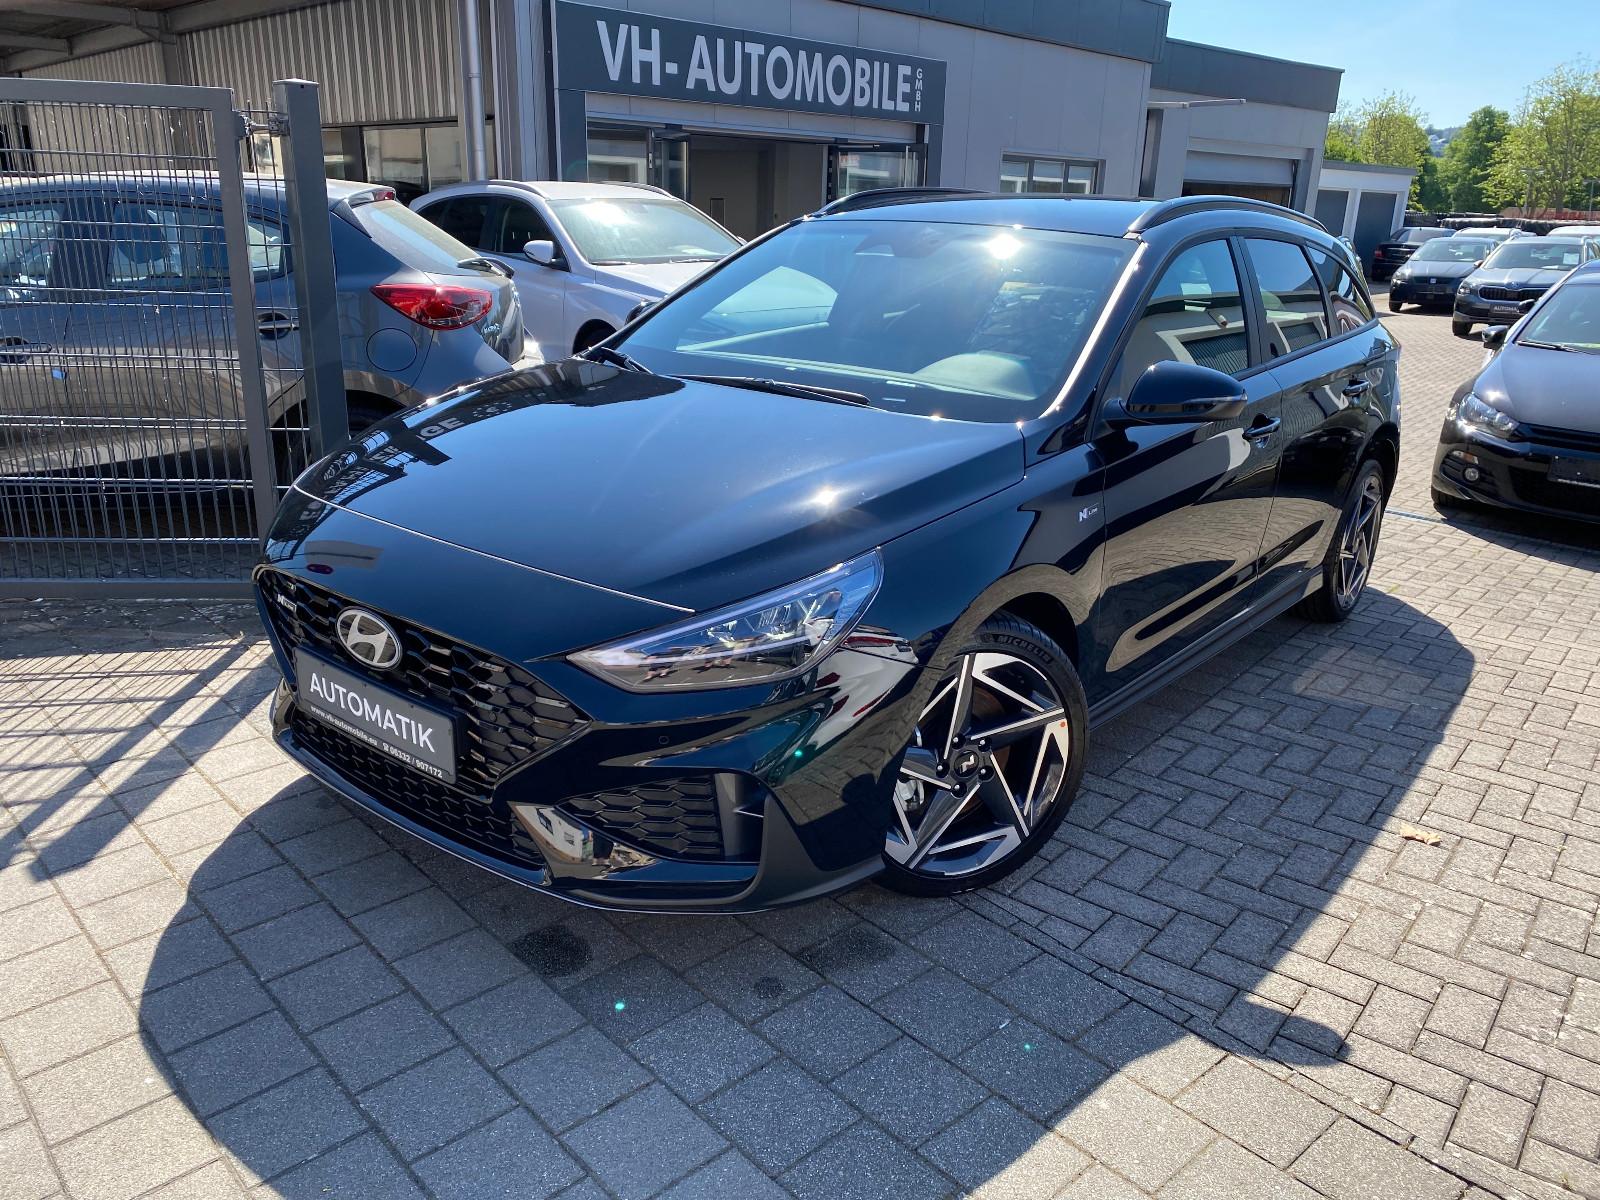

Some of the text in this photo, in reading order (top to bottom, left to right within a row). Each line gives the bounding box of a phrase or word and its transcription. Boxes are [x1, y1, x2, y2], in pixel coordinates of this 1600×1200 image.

[596, 20, 912, 113] VH- AUTOMOBILE
[914, 67, 923, 112] GMBH
[309, 671, 435, 753] AUTOMATIK
[310, 705, 378, 746] www.vh-automobile.eu
[416, 759, 443, 779] 907172
